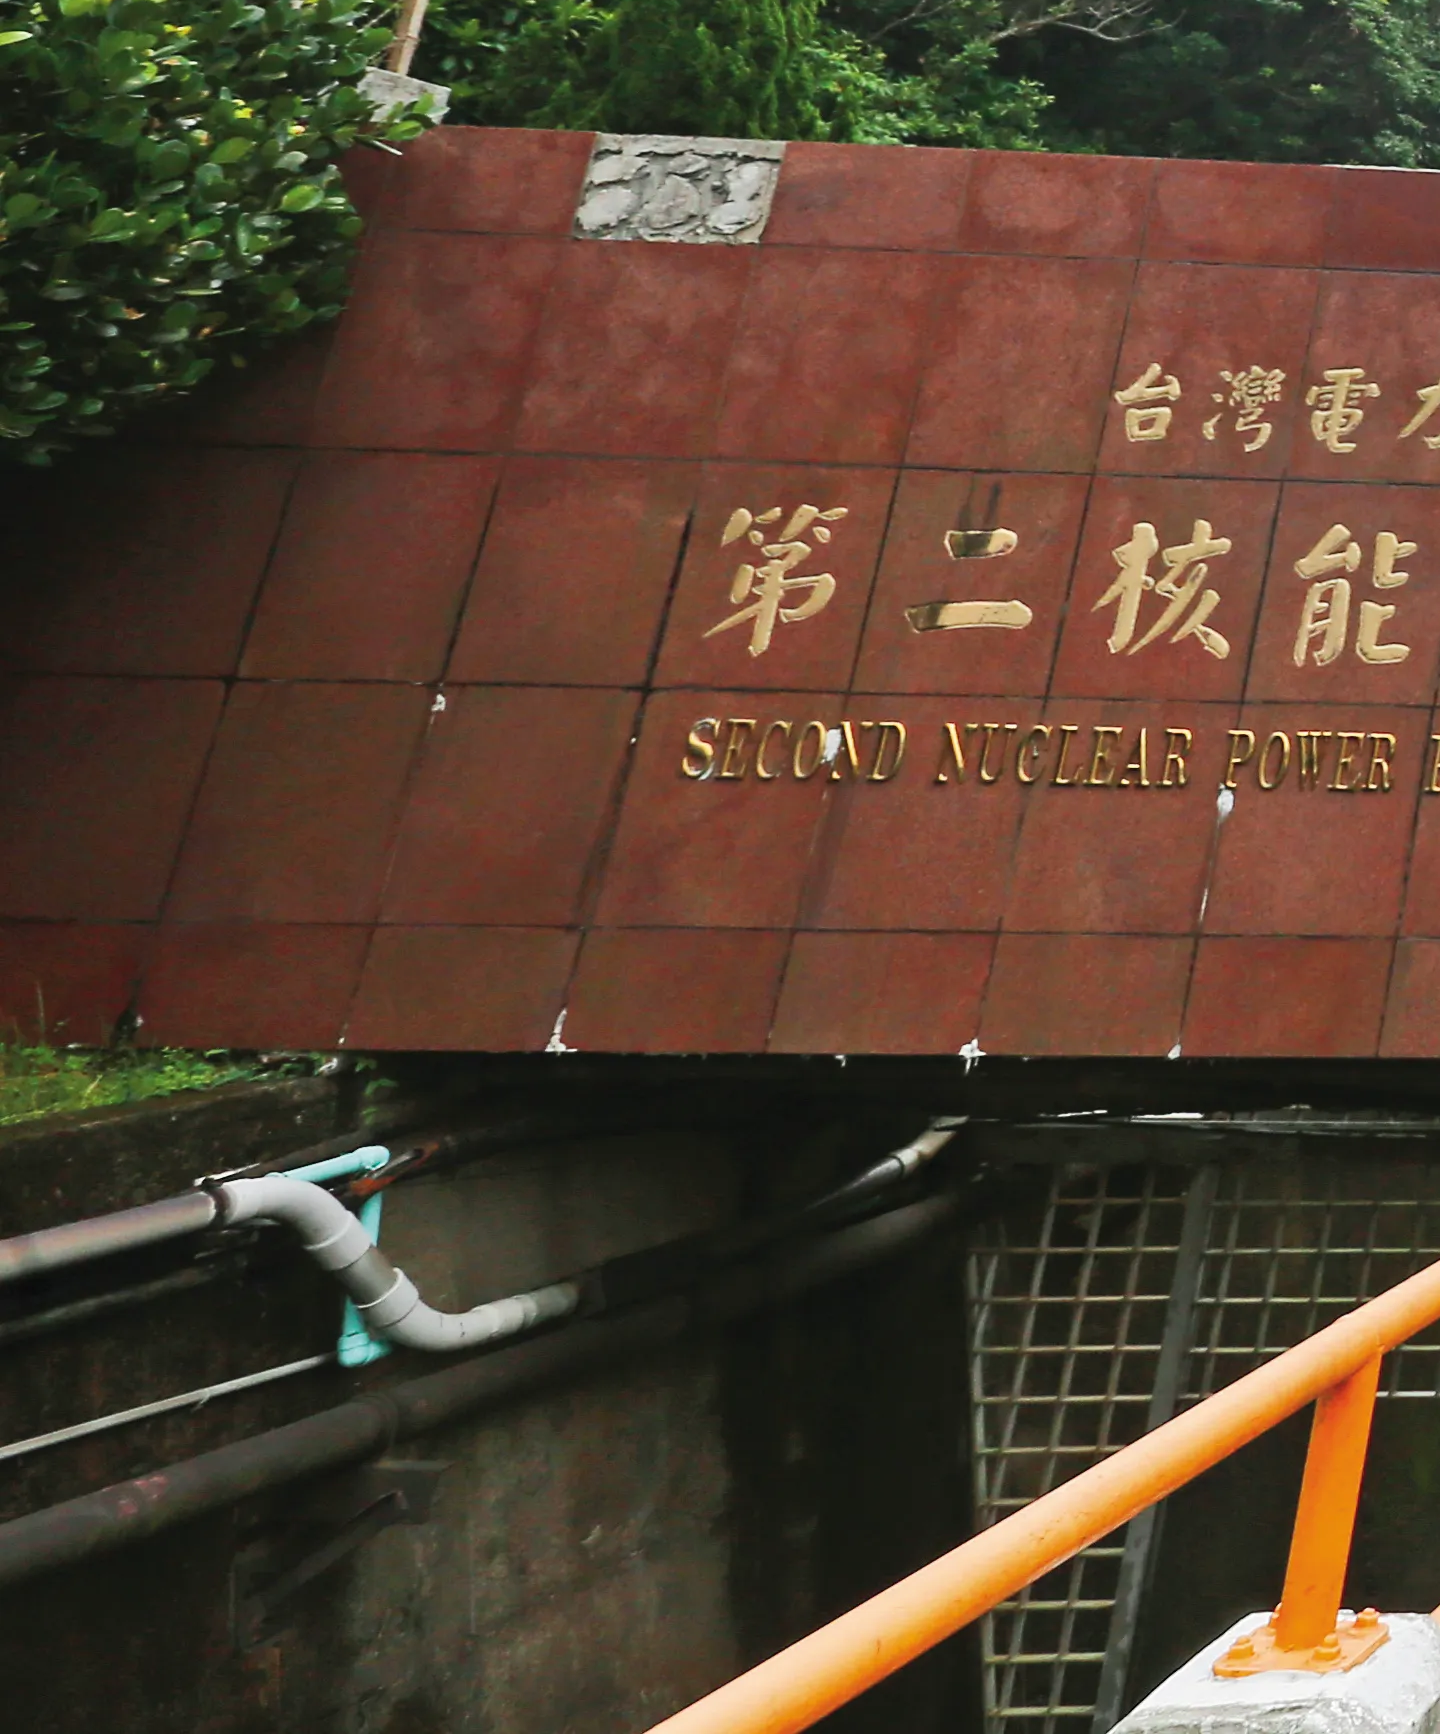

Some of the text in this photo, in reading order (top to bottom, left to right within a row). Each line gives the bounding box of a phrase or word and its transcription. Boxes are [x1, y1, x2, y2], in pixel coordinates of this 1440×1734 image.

[682, 718, 907, 782] SECOND
[934, 721, 1194, 787] NUCLEAR
[1223, 728, 1397, 792] POWER
